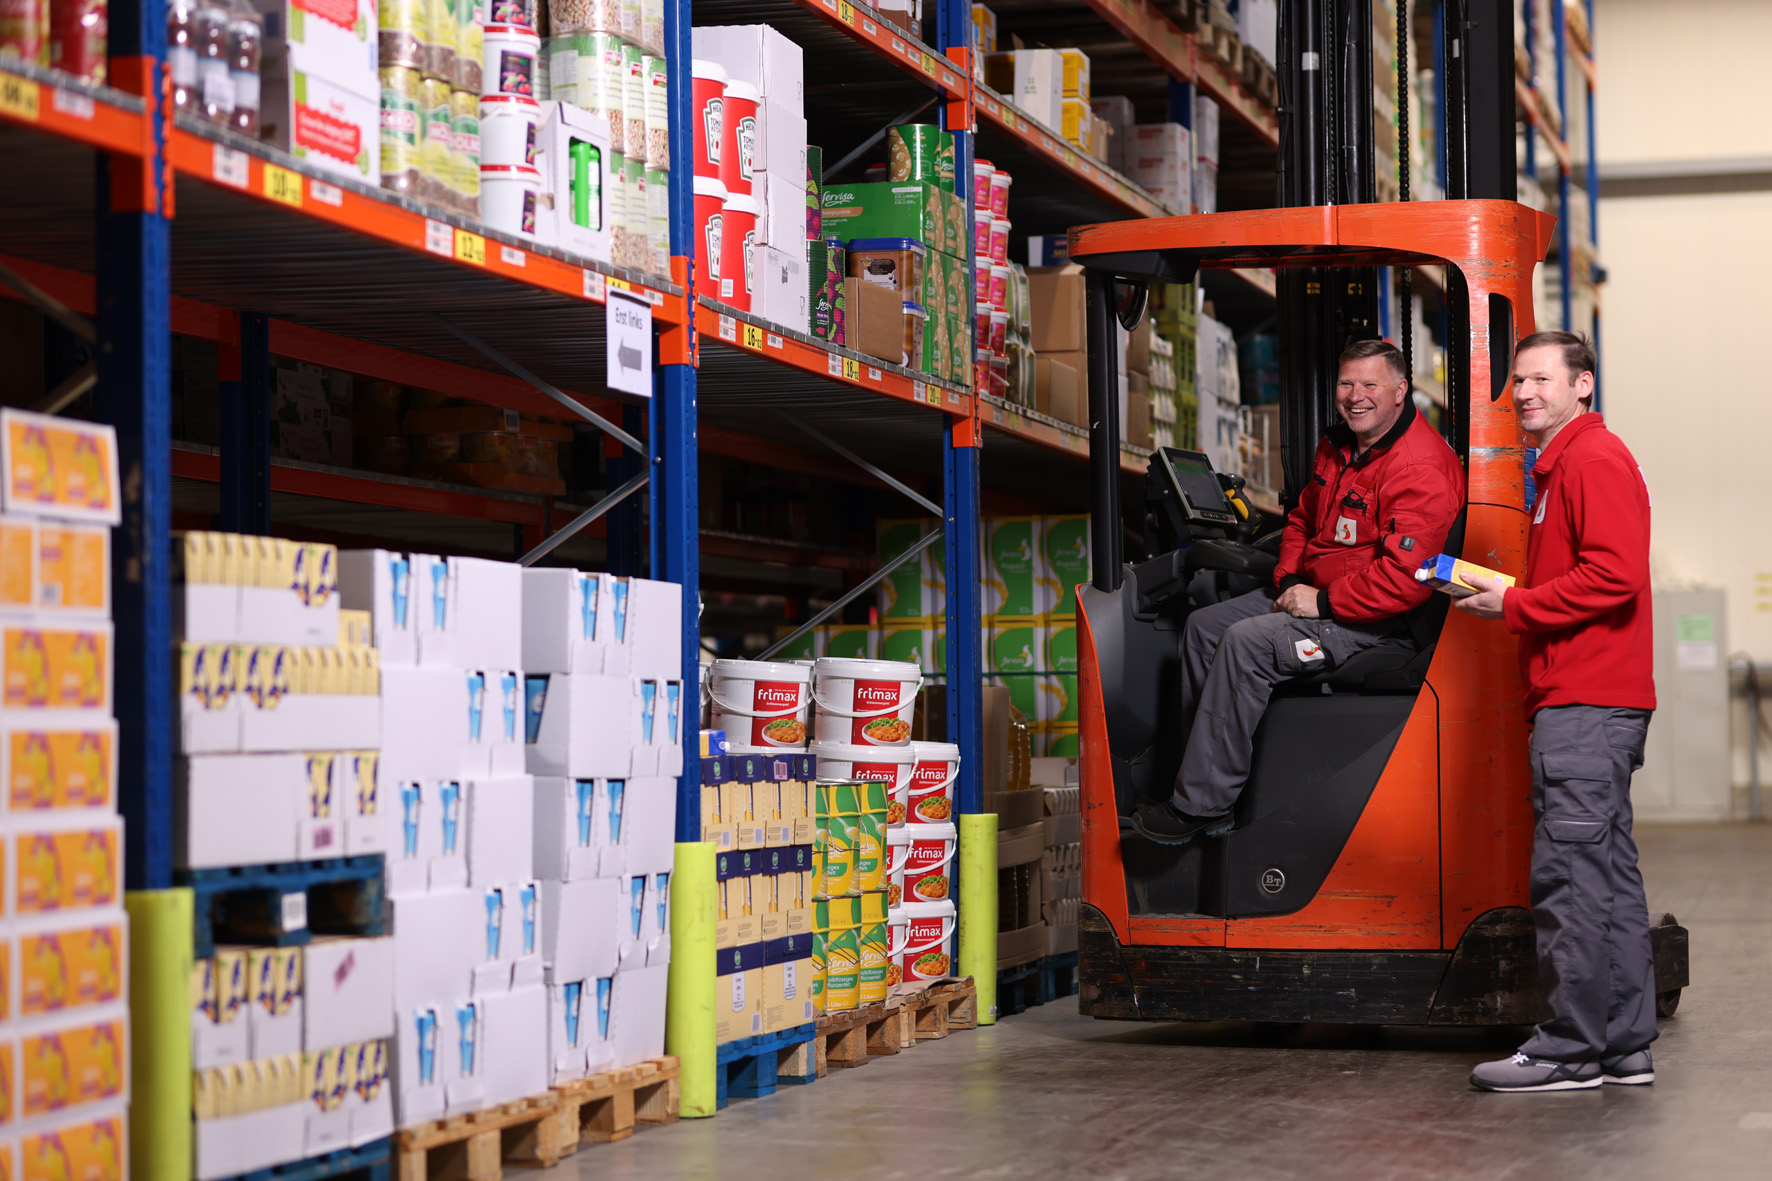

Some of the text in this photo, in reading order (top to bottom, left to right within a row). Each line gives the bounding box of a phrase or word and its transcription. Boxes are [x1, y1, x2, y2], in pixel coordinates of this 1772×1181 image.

[615, 306, 643, 330] Erst links
[758, 688, 797, 702] frimax
[857, 687, 898, 700] frimax
[912, 767, 946, 780] frimax
[909, 847, 943, 859] frimax
[1265, 874, 1282, 887] BT
